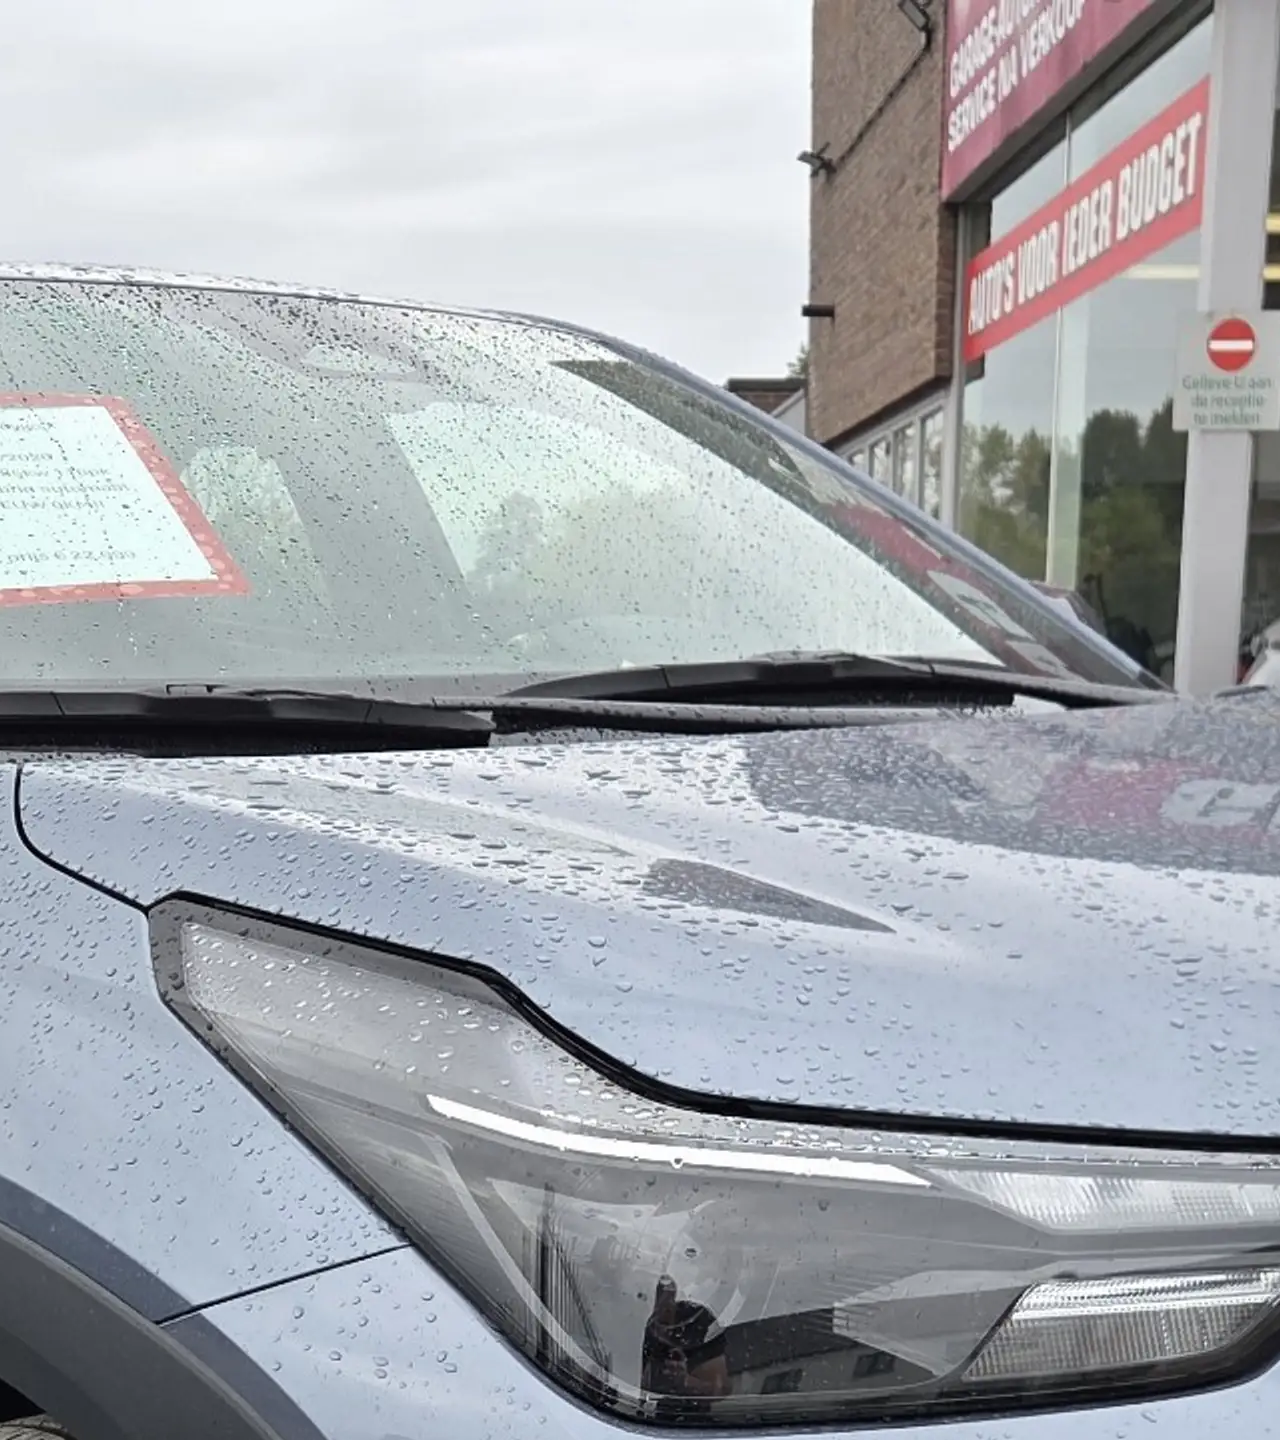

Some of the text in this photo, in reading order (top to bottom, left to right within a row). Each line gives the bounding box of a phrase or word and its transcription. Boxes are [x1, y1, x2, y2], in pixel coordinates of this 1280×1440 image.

[948, 66, 996, 152] SERVICE
[968, 112, 1202, 336] AUTO'S VOOR IEDER BUDGET
